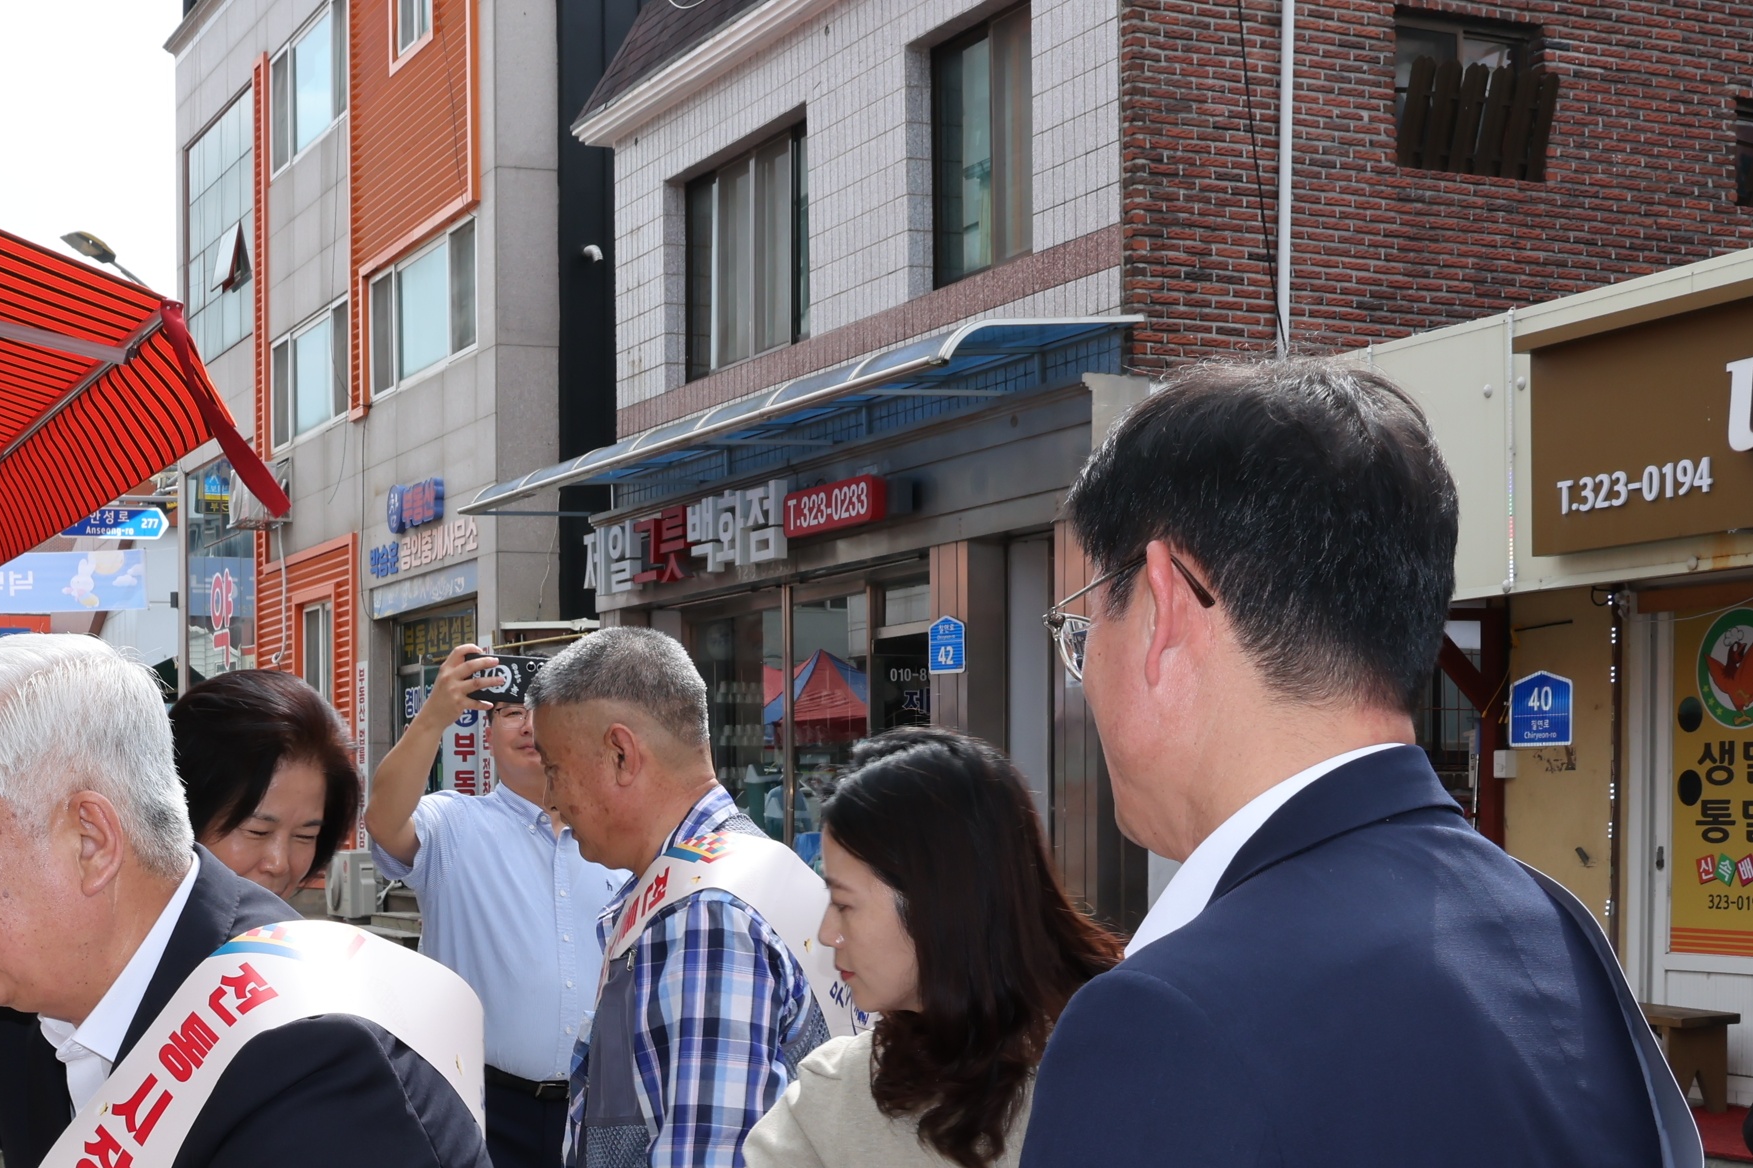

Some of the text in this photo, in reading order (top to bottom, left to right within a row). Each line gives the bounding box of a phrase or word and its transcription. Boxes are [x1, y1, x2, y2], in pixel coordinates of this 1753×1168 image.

[1556, 457, 1714, 515] T.323-0194
[402, 478, 436, 529] 부동산
[787, 481, 868, 531] T.323-0233
[89, 510, 130, 525] 안성로
[140, 518, 159, 529] 277
[85, 526, 135, 537] Anseong-ro
[370, 516, 478, 579] 박승훈 공인중개사무소
[938, 646, 954, 665] 42
[1528, 686, 1552, 711] 40
[1531, 720, 1549, 730] 칠연로
[1524, 731, 1557, 740] Chiryeon-ro
